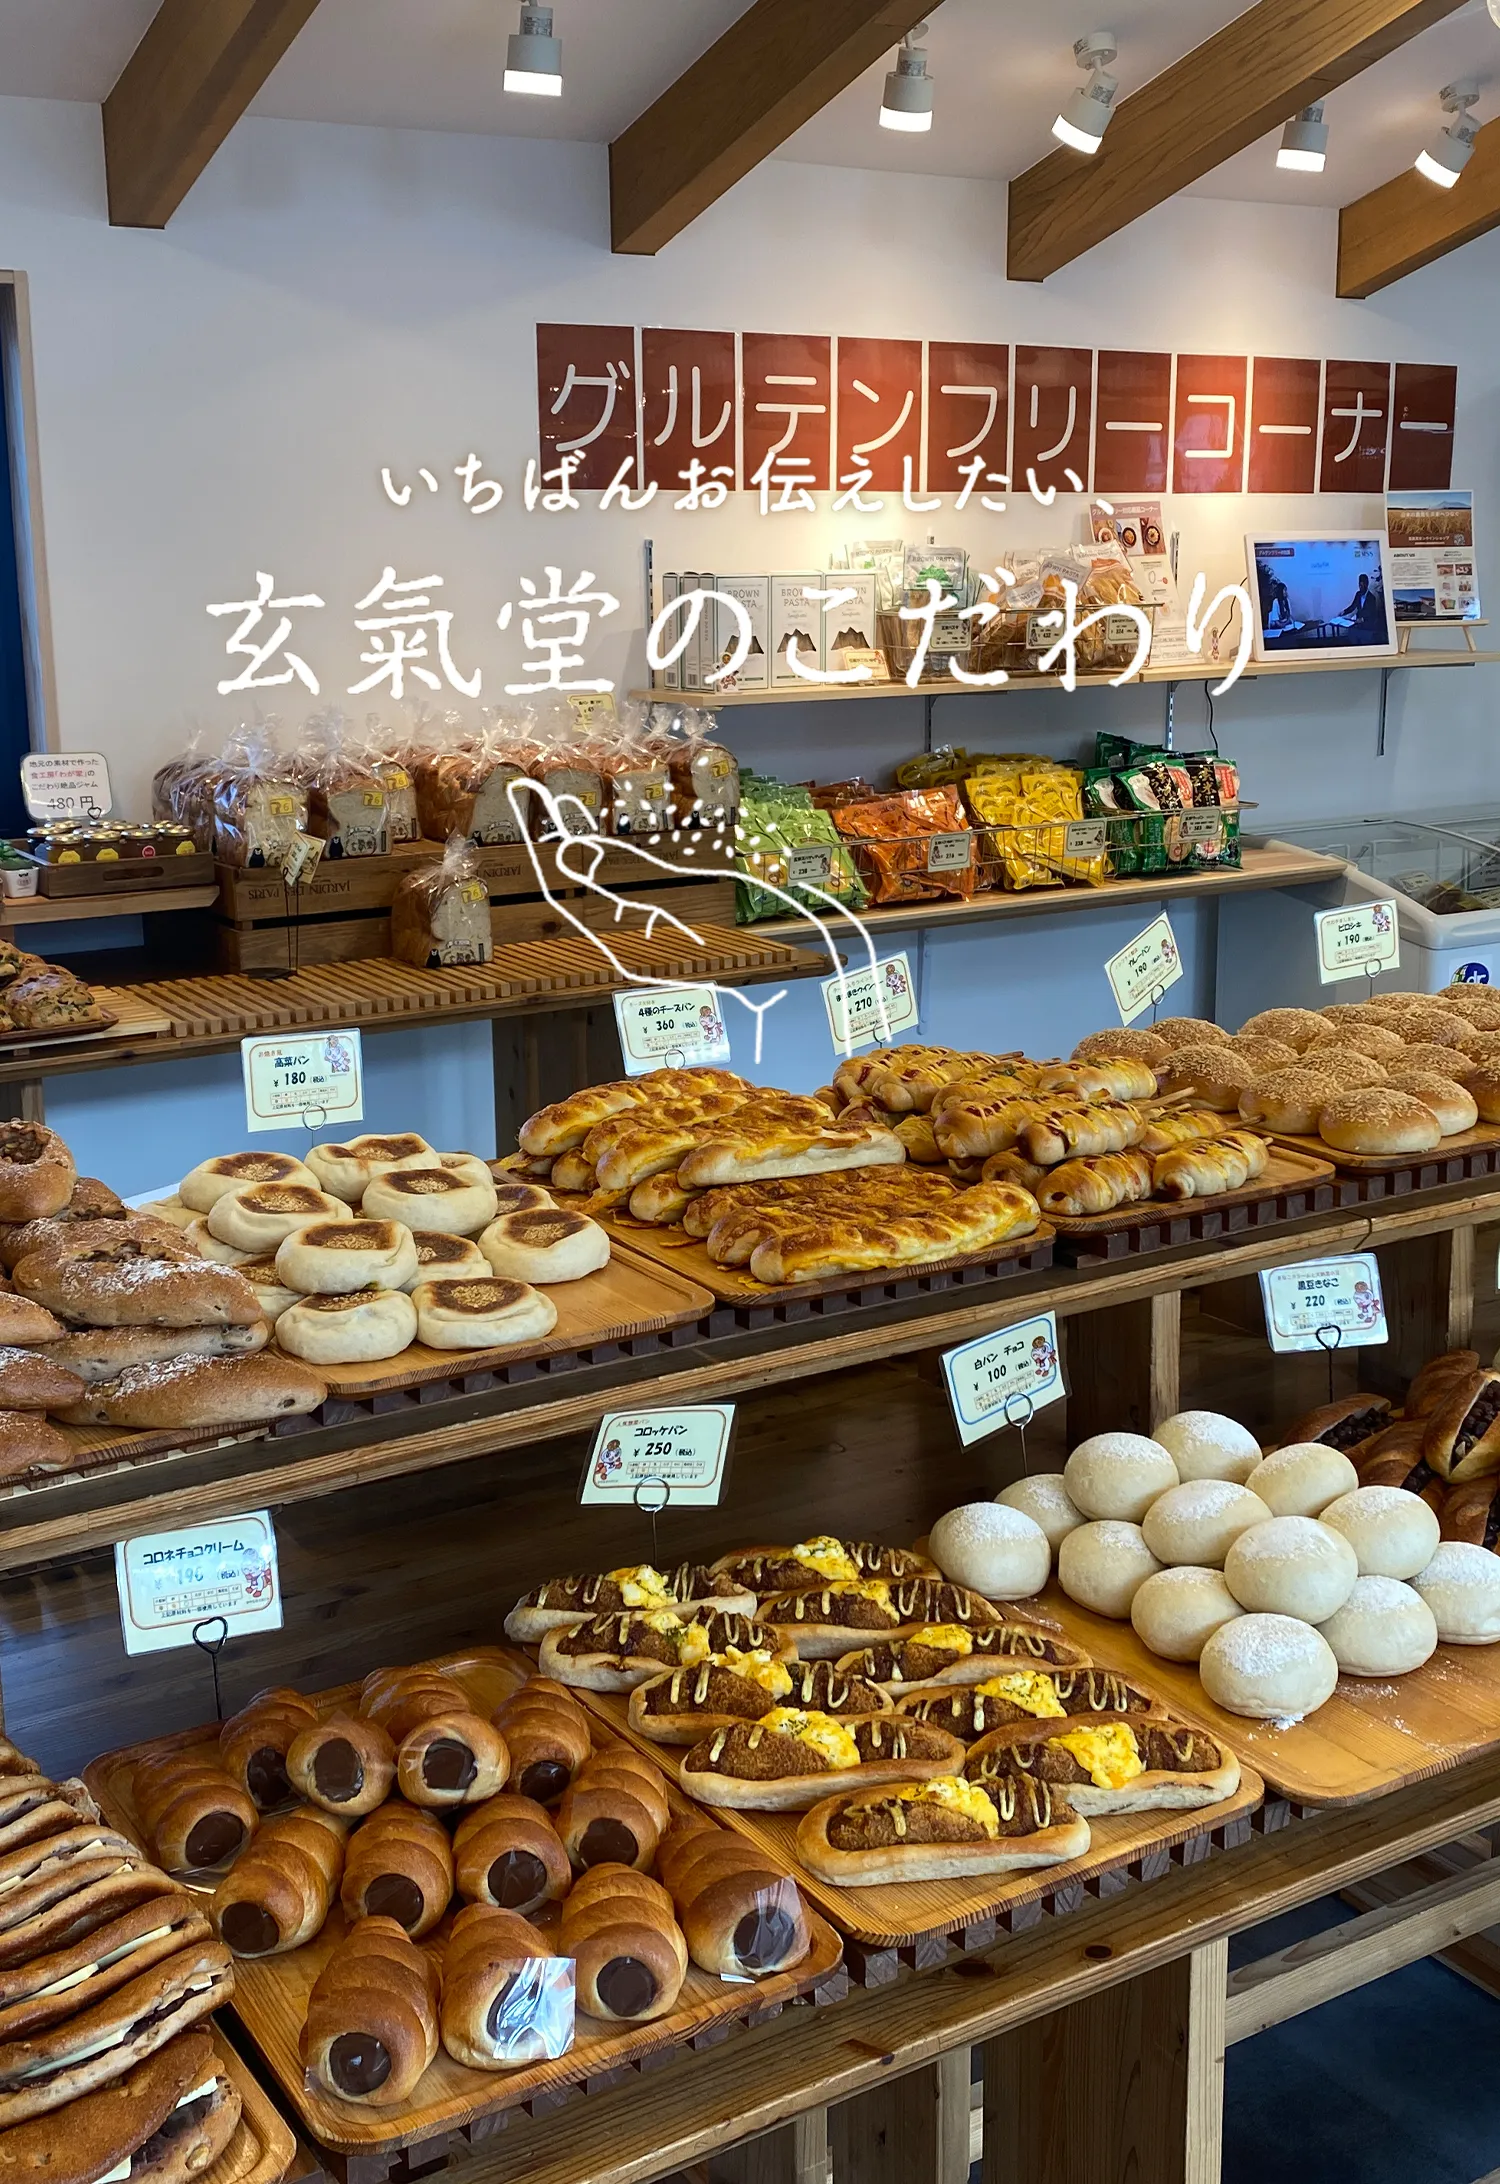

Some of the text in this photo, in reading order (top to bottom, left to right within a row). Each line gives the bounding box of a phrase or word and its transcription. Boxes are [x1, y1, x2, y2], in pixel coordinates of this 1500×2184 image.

[551, 360, 1448, 463] グルテンフリーコーナー
[783, 598, 810, 607] PASTA
[29, 758, 99, 768] 地元の素材で作った
[32, 782, 98, 791] こだわり絶品ジャム
[47, 795, 94, 810] 480 円
[484, 864, 521, 878] JARDIN
[248, 888, 280, 900] PARIS
[1338, 922, 1362, 932] ピロシキ
[1344, 933, 1360, 945] 190
[1135, 962, 1147, 977] 190
[638, 1002, 695, 1017] 4種のチーズパン
[855, 997, 872, 1011] 270
[656, 1019, 675, 1031] 360
[274, 1055, 310, 1068] 高菜パン
[285, 1071, 306, 1085] 180
[1298, 1277, 1339, 1290] 黒豆きなこ
[1305, 1295, 1325, 1307] 220
[974, 1341, 1024, 1370] 白パン チョコ
[988, 1365, 1007, 1382] 100
[634, 1425, 688, 1438] コロッケパン
[645, 1442, 672, 1456] 250
[143, 1539, 245, 1565] コロネチョコクリーム
